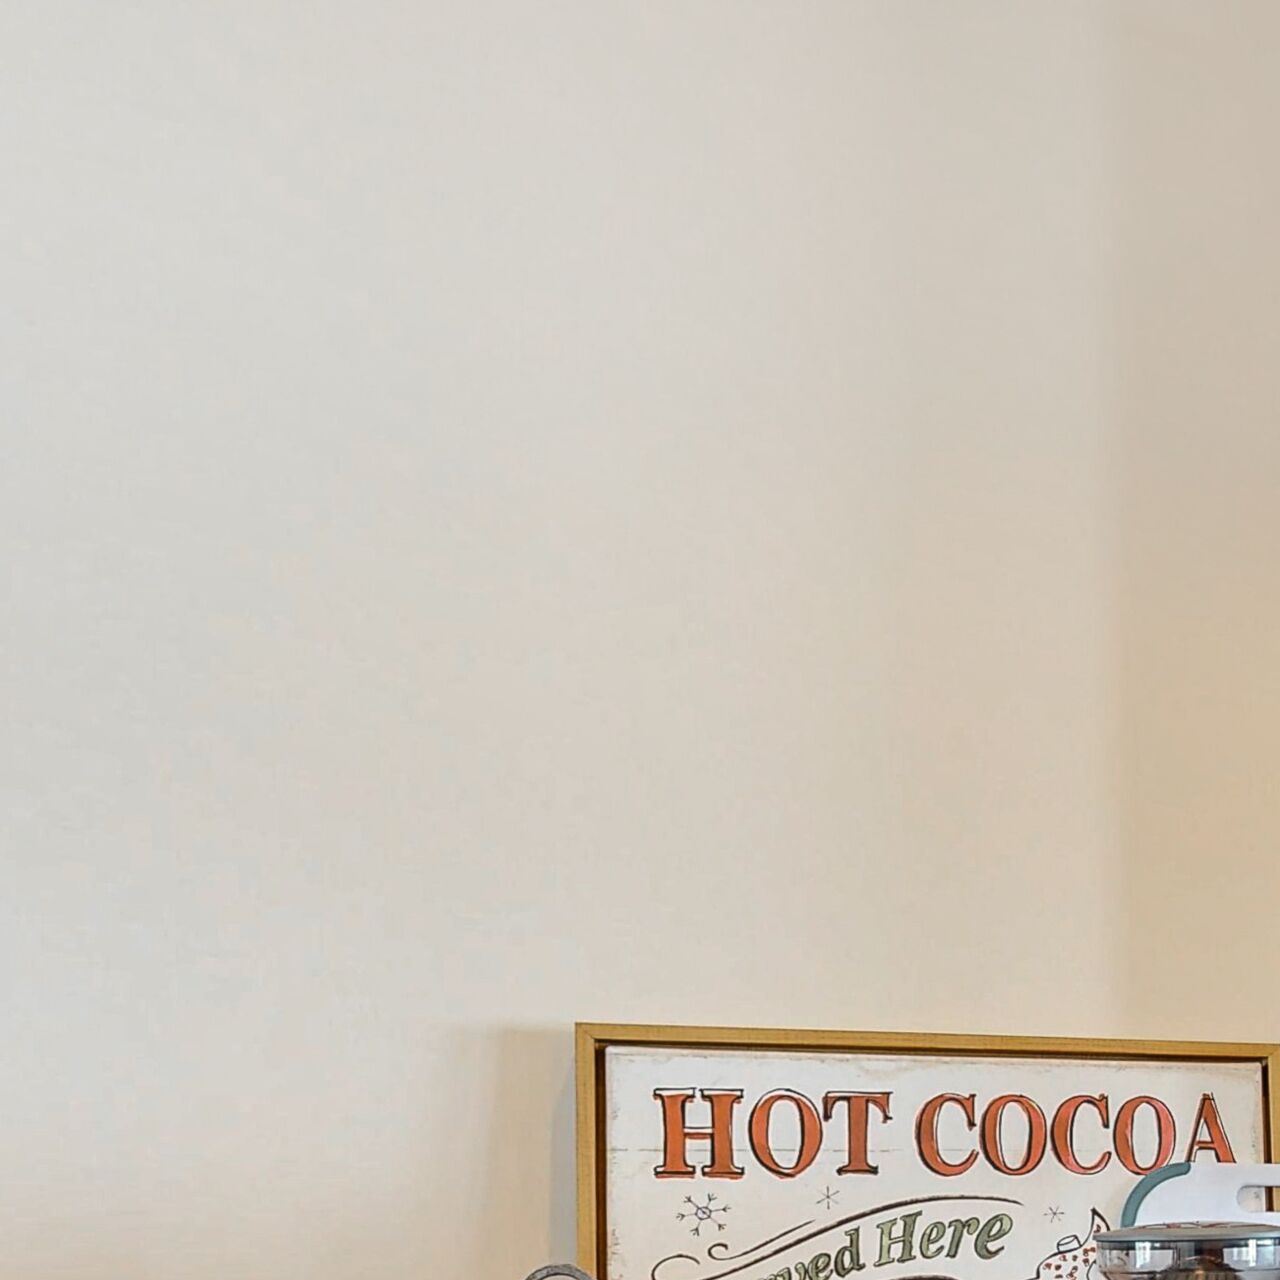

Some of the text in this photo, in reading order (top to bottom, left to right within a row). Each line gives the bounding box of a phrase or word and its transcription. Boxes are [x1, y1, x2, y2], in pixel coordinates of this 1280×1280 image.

[653, 1088, 1237, 1178] HOT COCOA
[873, 1200, 1014, 1268] Here
